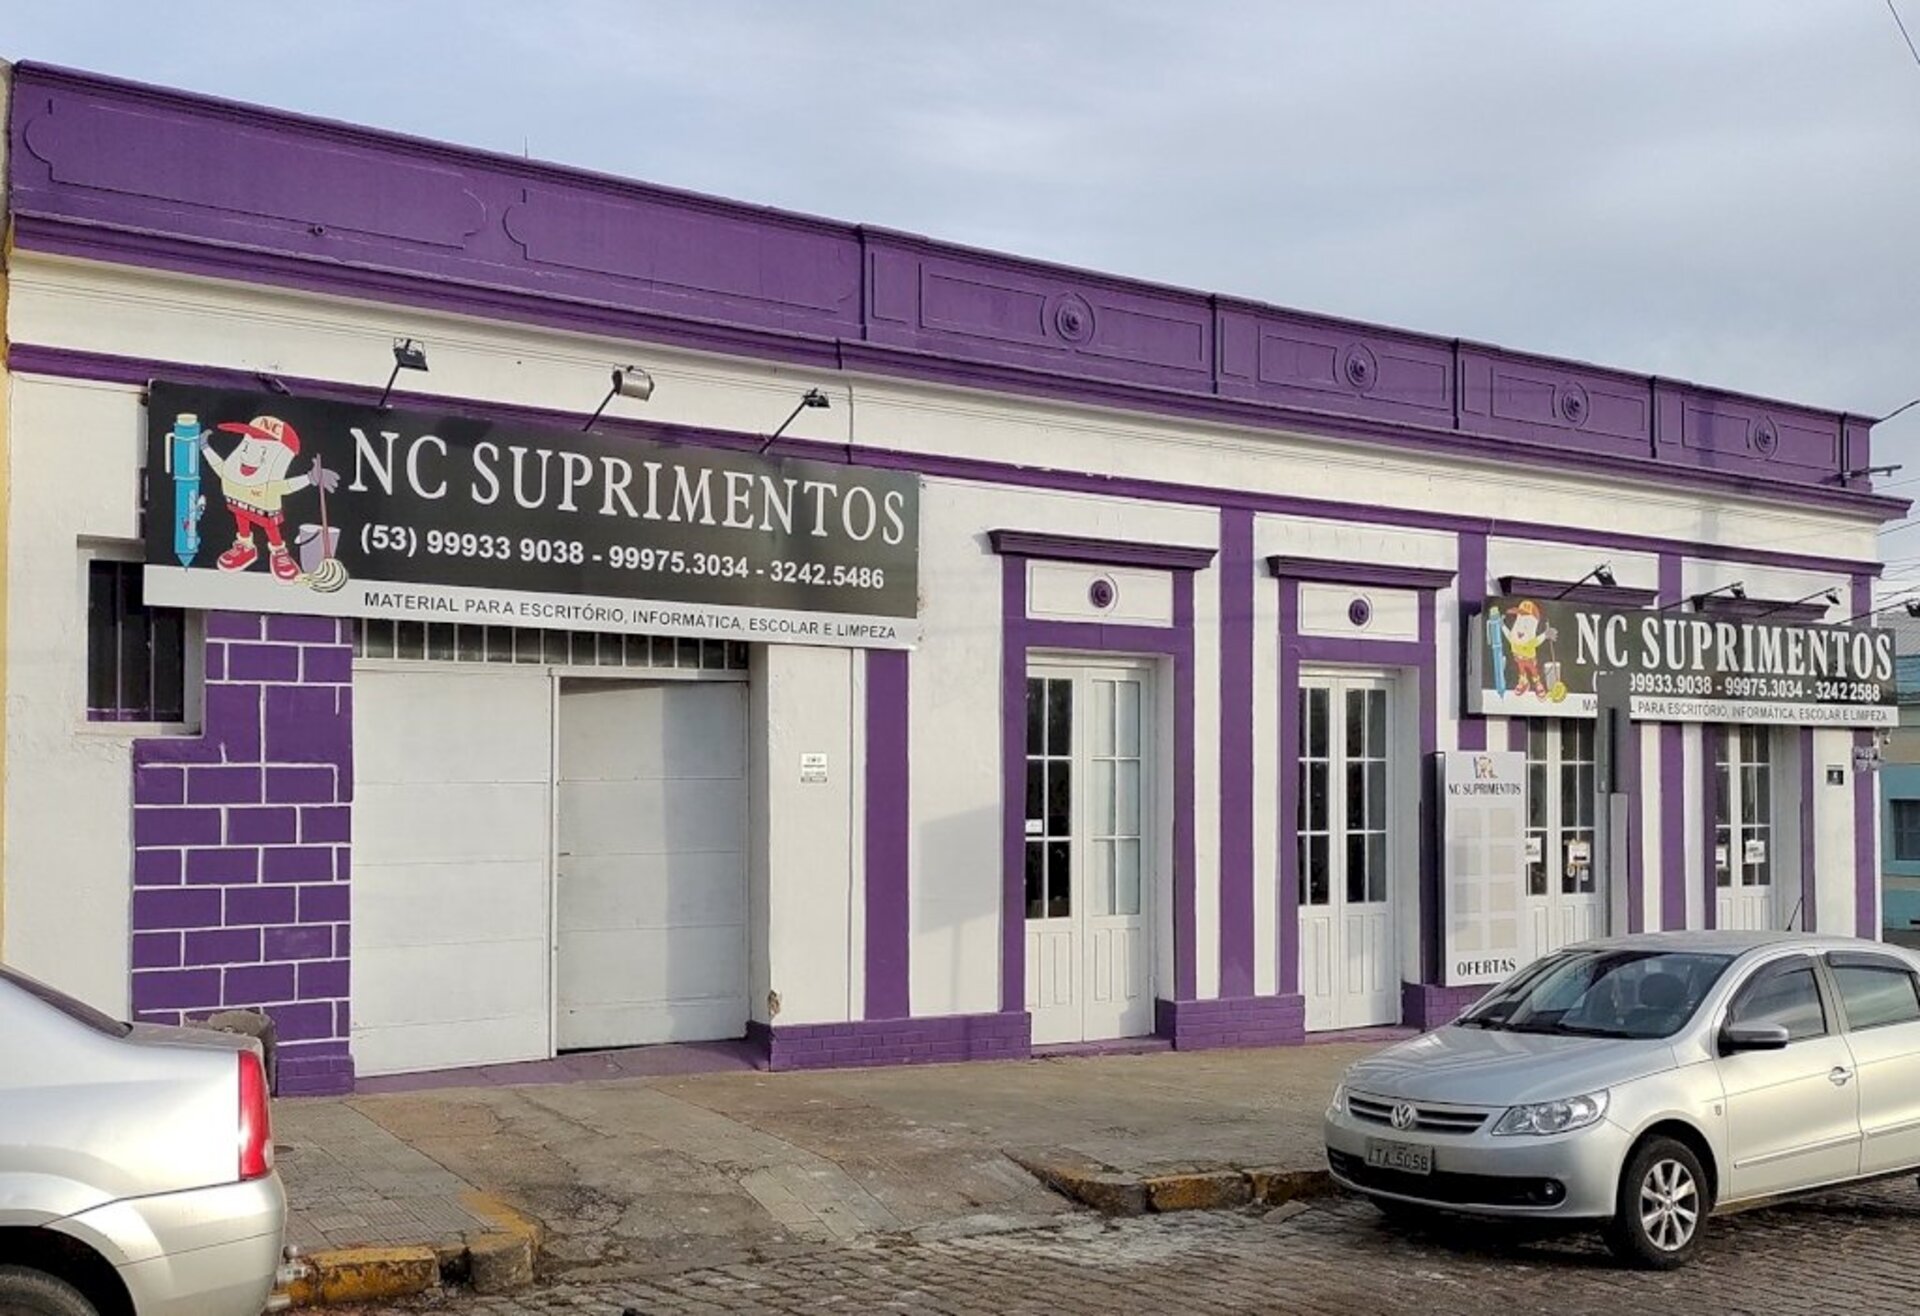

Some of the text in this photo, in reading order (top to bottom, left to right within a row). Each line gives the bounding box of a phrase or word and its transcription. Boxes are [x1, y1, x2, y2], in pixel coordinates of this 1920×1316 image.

[260, 418, 281, 434] NC
[348, 428, 905, 545] NC SUPRIMENTOS
[361, 523, 417, 558] (53)
[427, 530, 511, 560] 99933
[520, 538, 585, 564] 9038
[609, 545, 749, 578] 99975.3034
[770, 560, 885, 590] 3242.5486
[364, 592, 896, 639] MATERIAL PARA ESCRITÓRIO, INFORMÁTICA, ESCOLAR E LIMPEZA
[1575, 612, 1893, 682] NC SUPRIMENTOS
[1725, 677, 1803, 698] 99975.3034
[1638, 702, 1665, 714] PARA
[1799, 708, 1839, 721] ESCOLAR
[1852, 709, 1888, 722] LIMPEZA
[1457, 959, 1516, 977] OFERTAS
